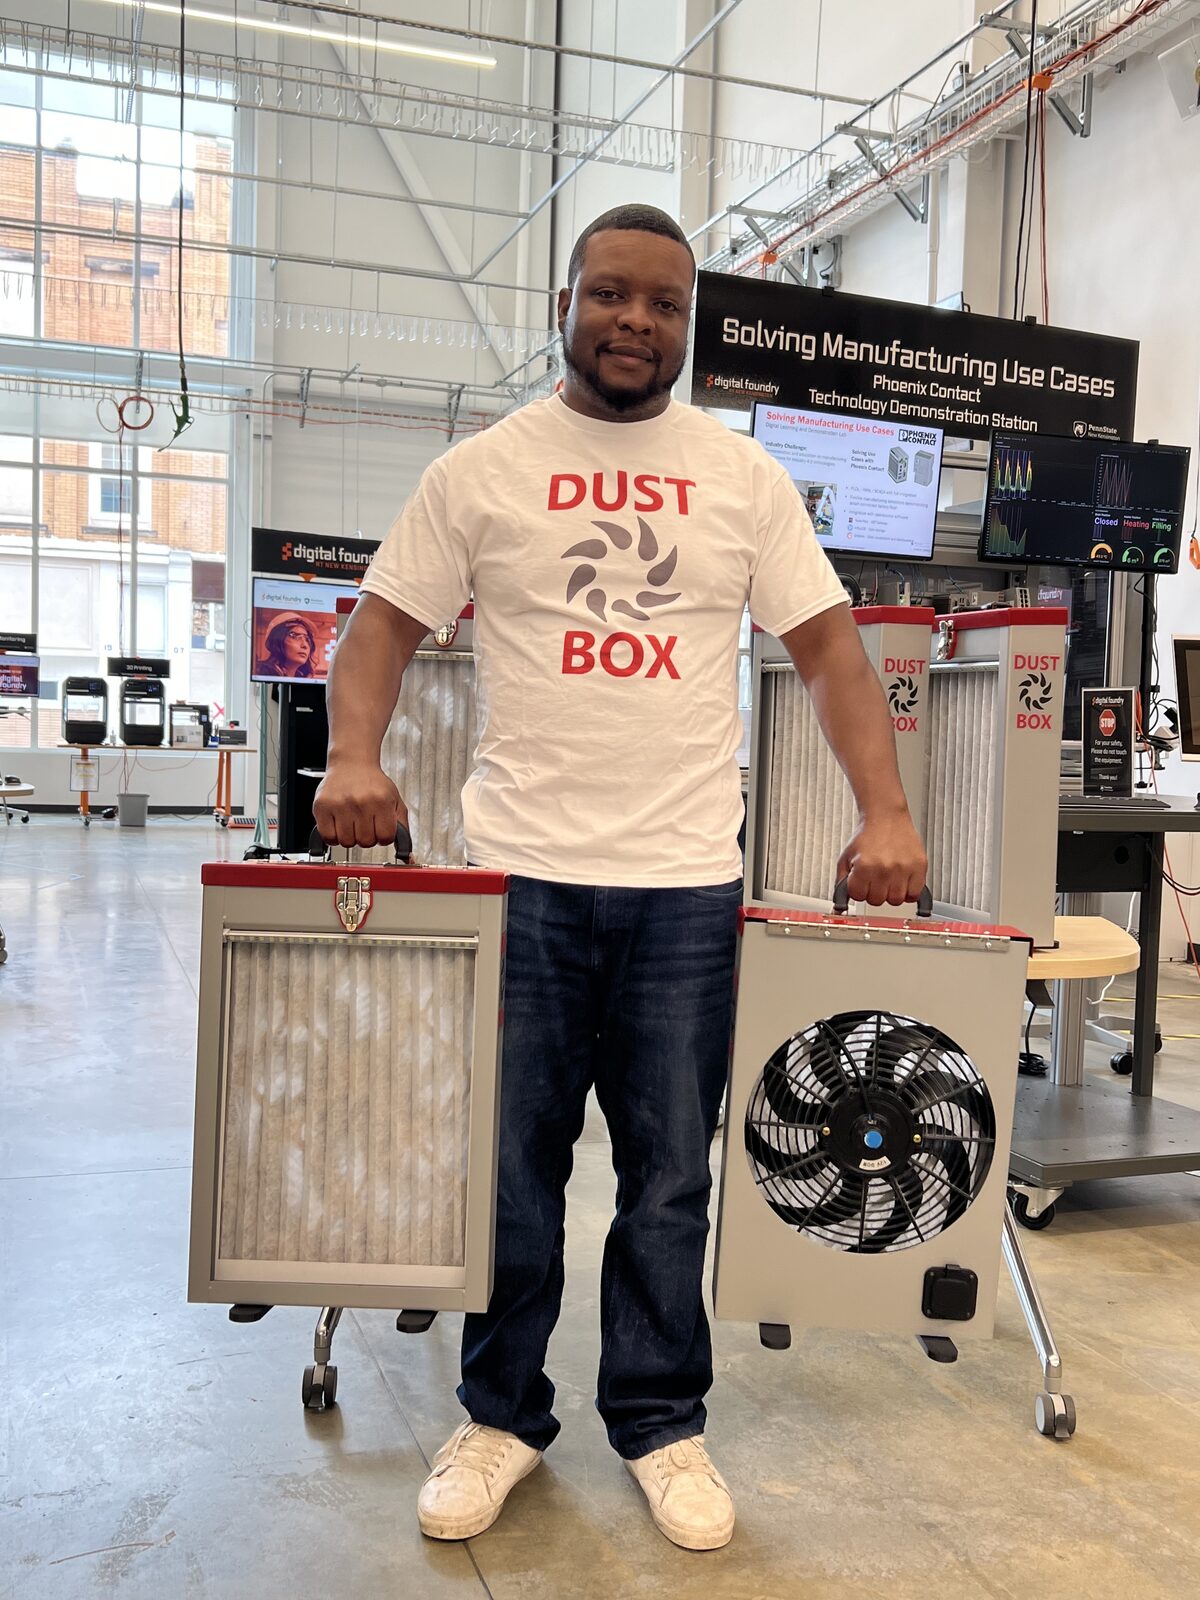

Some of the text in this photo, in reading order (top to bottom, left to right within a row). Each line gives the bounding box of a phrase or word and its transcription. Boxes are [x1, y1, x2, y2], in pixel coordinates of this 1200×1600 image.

[722, 317, 1115, 398] Solving Manufacturing Use Cases
[714, 375, 744, 390] digital
[744, 378, 780, 396] foundry
[873, 374, 981, 403] Phoenix Contact
[808, 388, 1038, 433] Technology Demonstration Station
[766, 411, 895, 437] Solving Manufacturing Use Cases
[1088, 423, 1118, 435] PennState
[907, 437, 937, 446] CONTACT
[547, 470, 697, 515] DUST
[1094, 517, 1119, 526] Closed
[1123, 519, 1150, 530] Heating
[1151, 521, 1172, 532] Filling
[293, 543, 376, 564] digital found
[341, 563, 369, 571] KENSING
[562, 630, 682, 680] BOX
[1013, 654, 1060, 672] DUST
[884, 657, 926, 675] DUST
[1108, 696, 1125, 706] foundry
[1016, 713, 1052, 731] BOX
[1100, 718, 1115, 728] STOP
